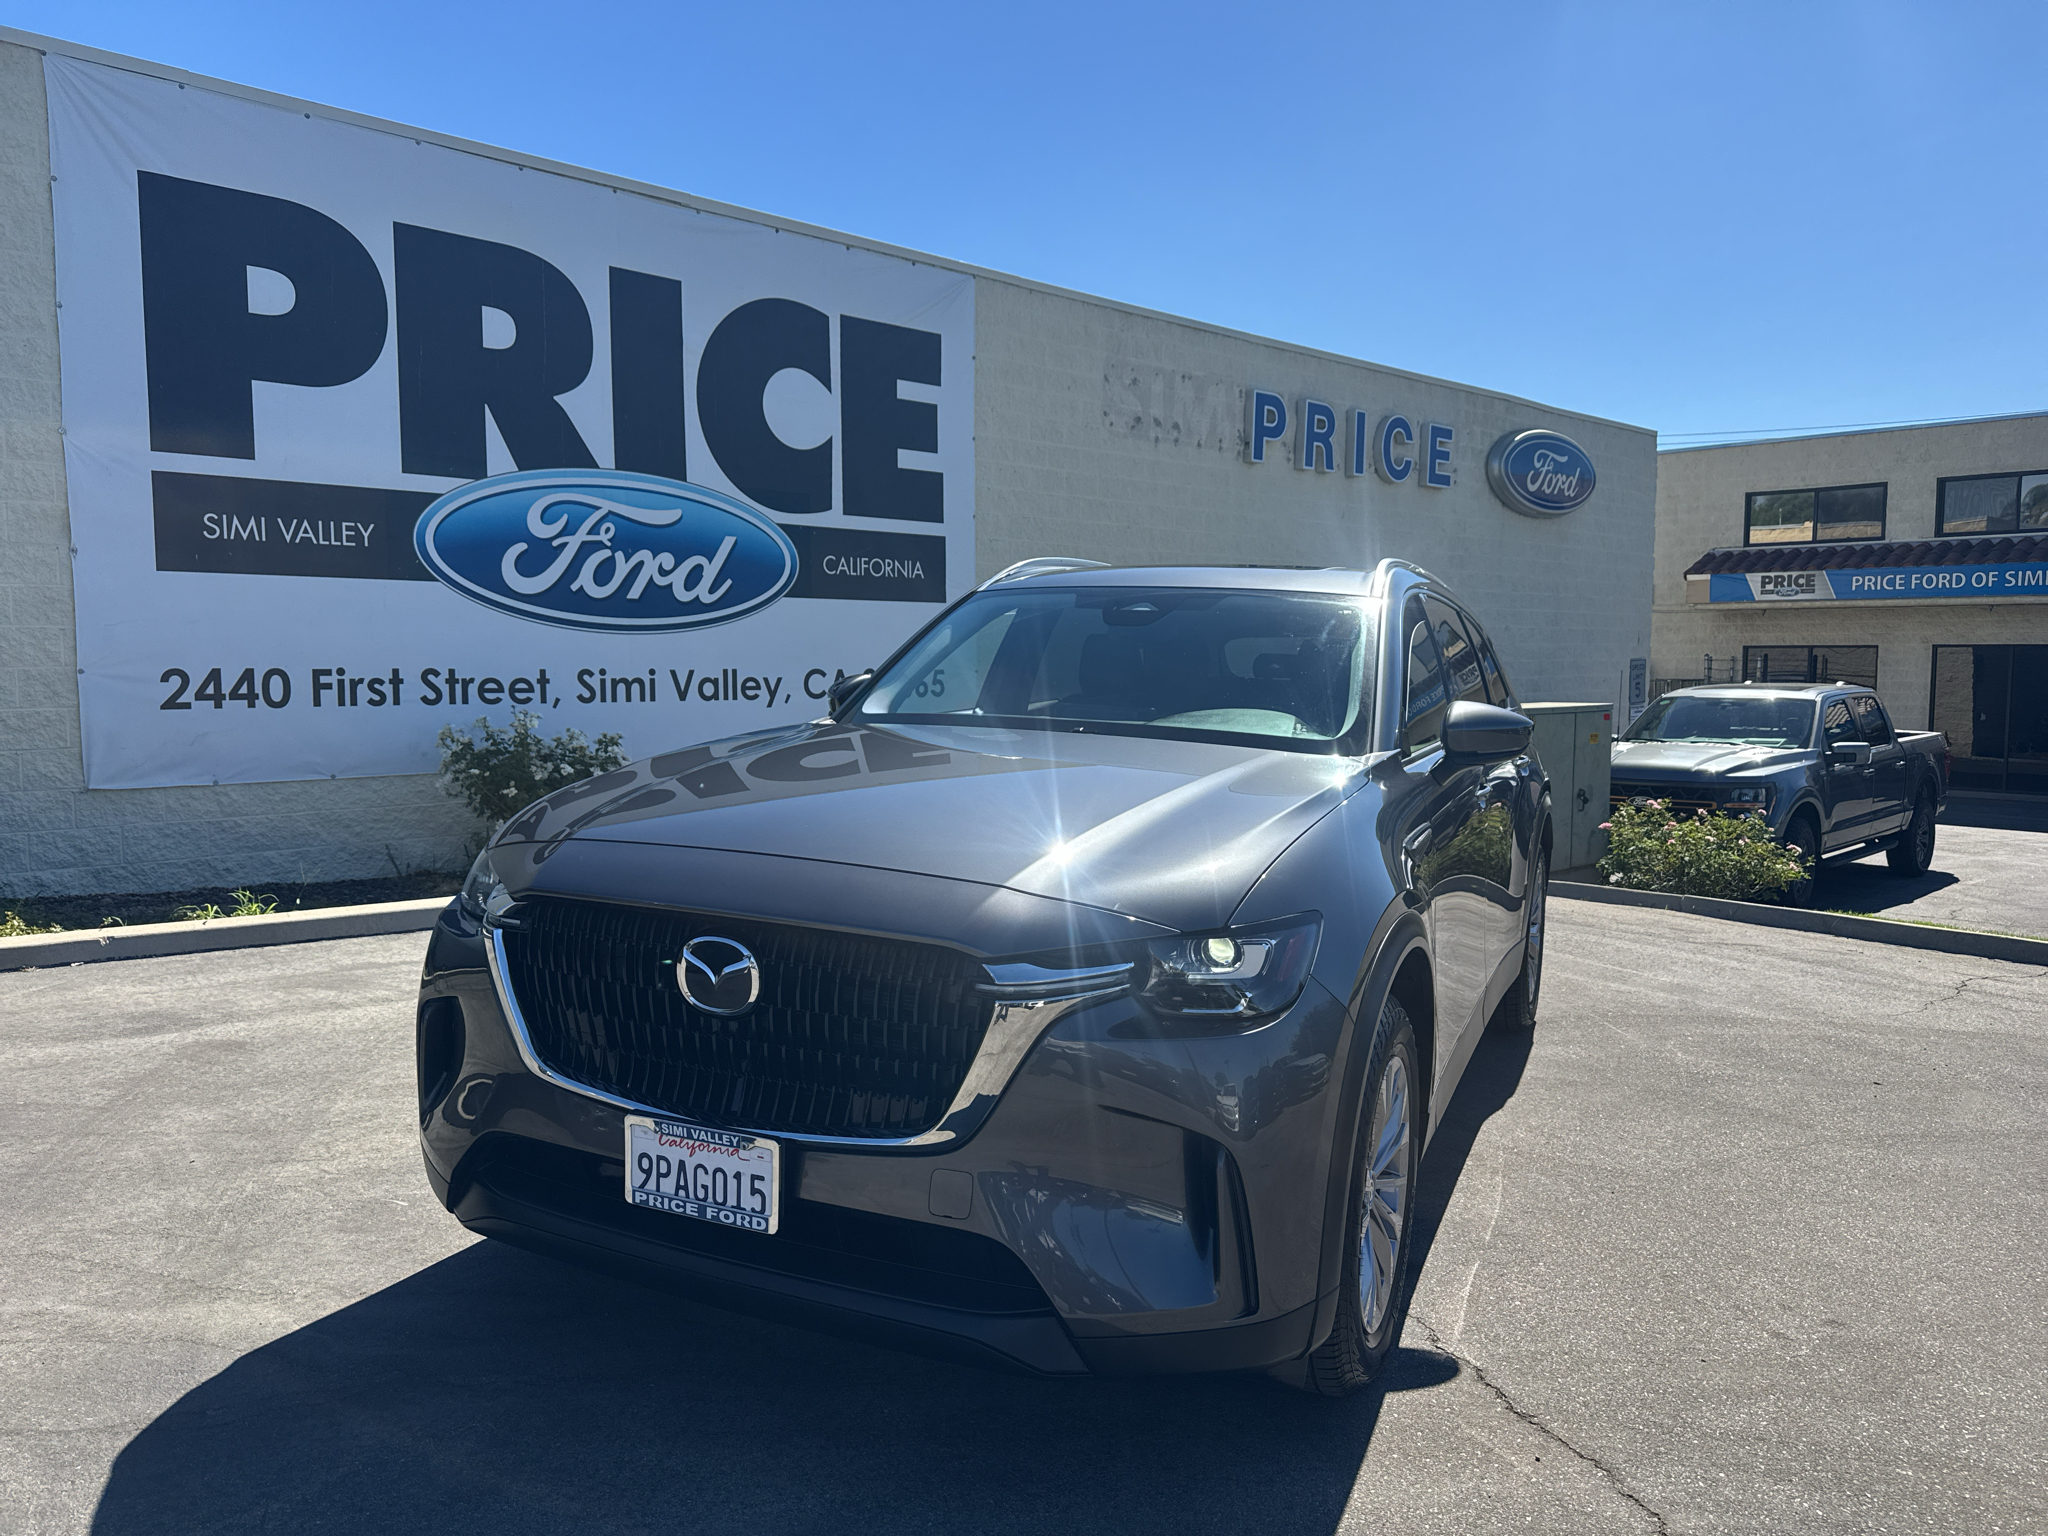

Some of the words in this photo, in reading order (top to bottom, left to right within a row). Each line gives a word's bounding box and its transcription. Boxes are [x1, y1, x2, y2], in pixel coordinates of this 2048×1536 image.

[137, 169, 944, 524] PRICE
[1250, 389, 1454, 489] PRICE
[1526, 449, 1580, 498] Ford
[203, 513, 266, 542] SIMI
[277, 517, 375, 547] VALLEY
[500, 492, 737, 604] Ford
[822, 555, 925, 580] CALIFORNIA
[1761, 573, 1816, 589] PRICE
[1851, 574, 1906, 591] PRICE
[1911, 572, 1966, 589] FORD
[1971, 571, 1999, 588] OF
[159, 667, 292, 710] 2440
[311, 666, 404, 707] First
[419, 667, 561, 709] Street,
[575, 667, 656, 704] Simi
[669, 668, 791, 708] Valley,
[1634, 682, 1641, 699] 5
[658, 1134, 750, 1161] California
[661, 1123, 688, 1138] SIMI
[691, 1129, 739, 1147] VALLEY
[637, 1152, 767, 1216] 9PAG015
[635, 1191, 699, 1216] PRICE
[706, 1206, 767, 1231] FORD
